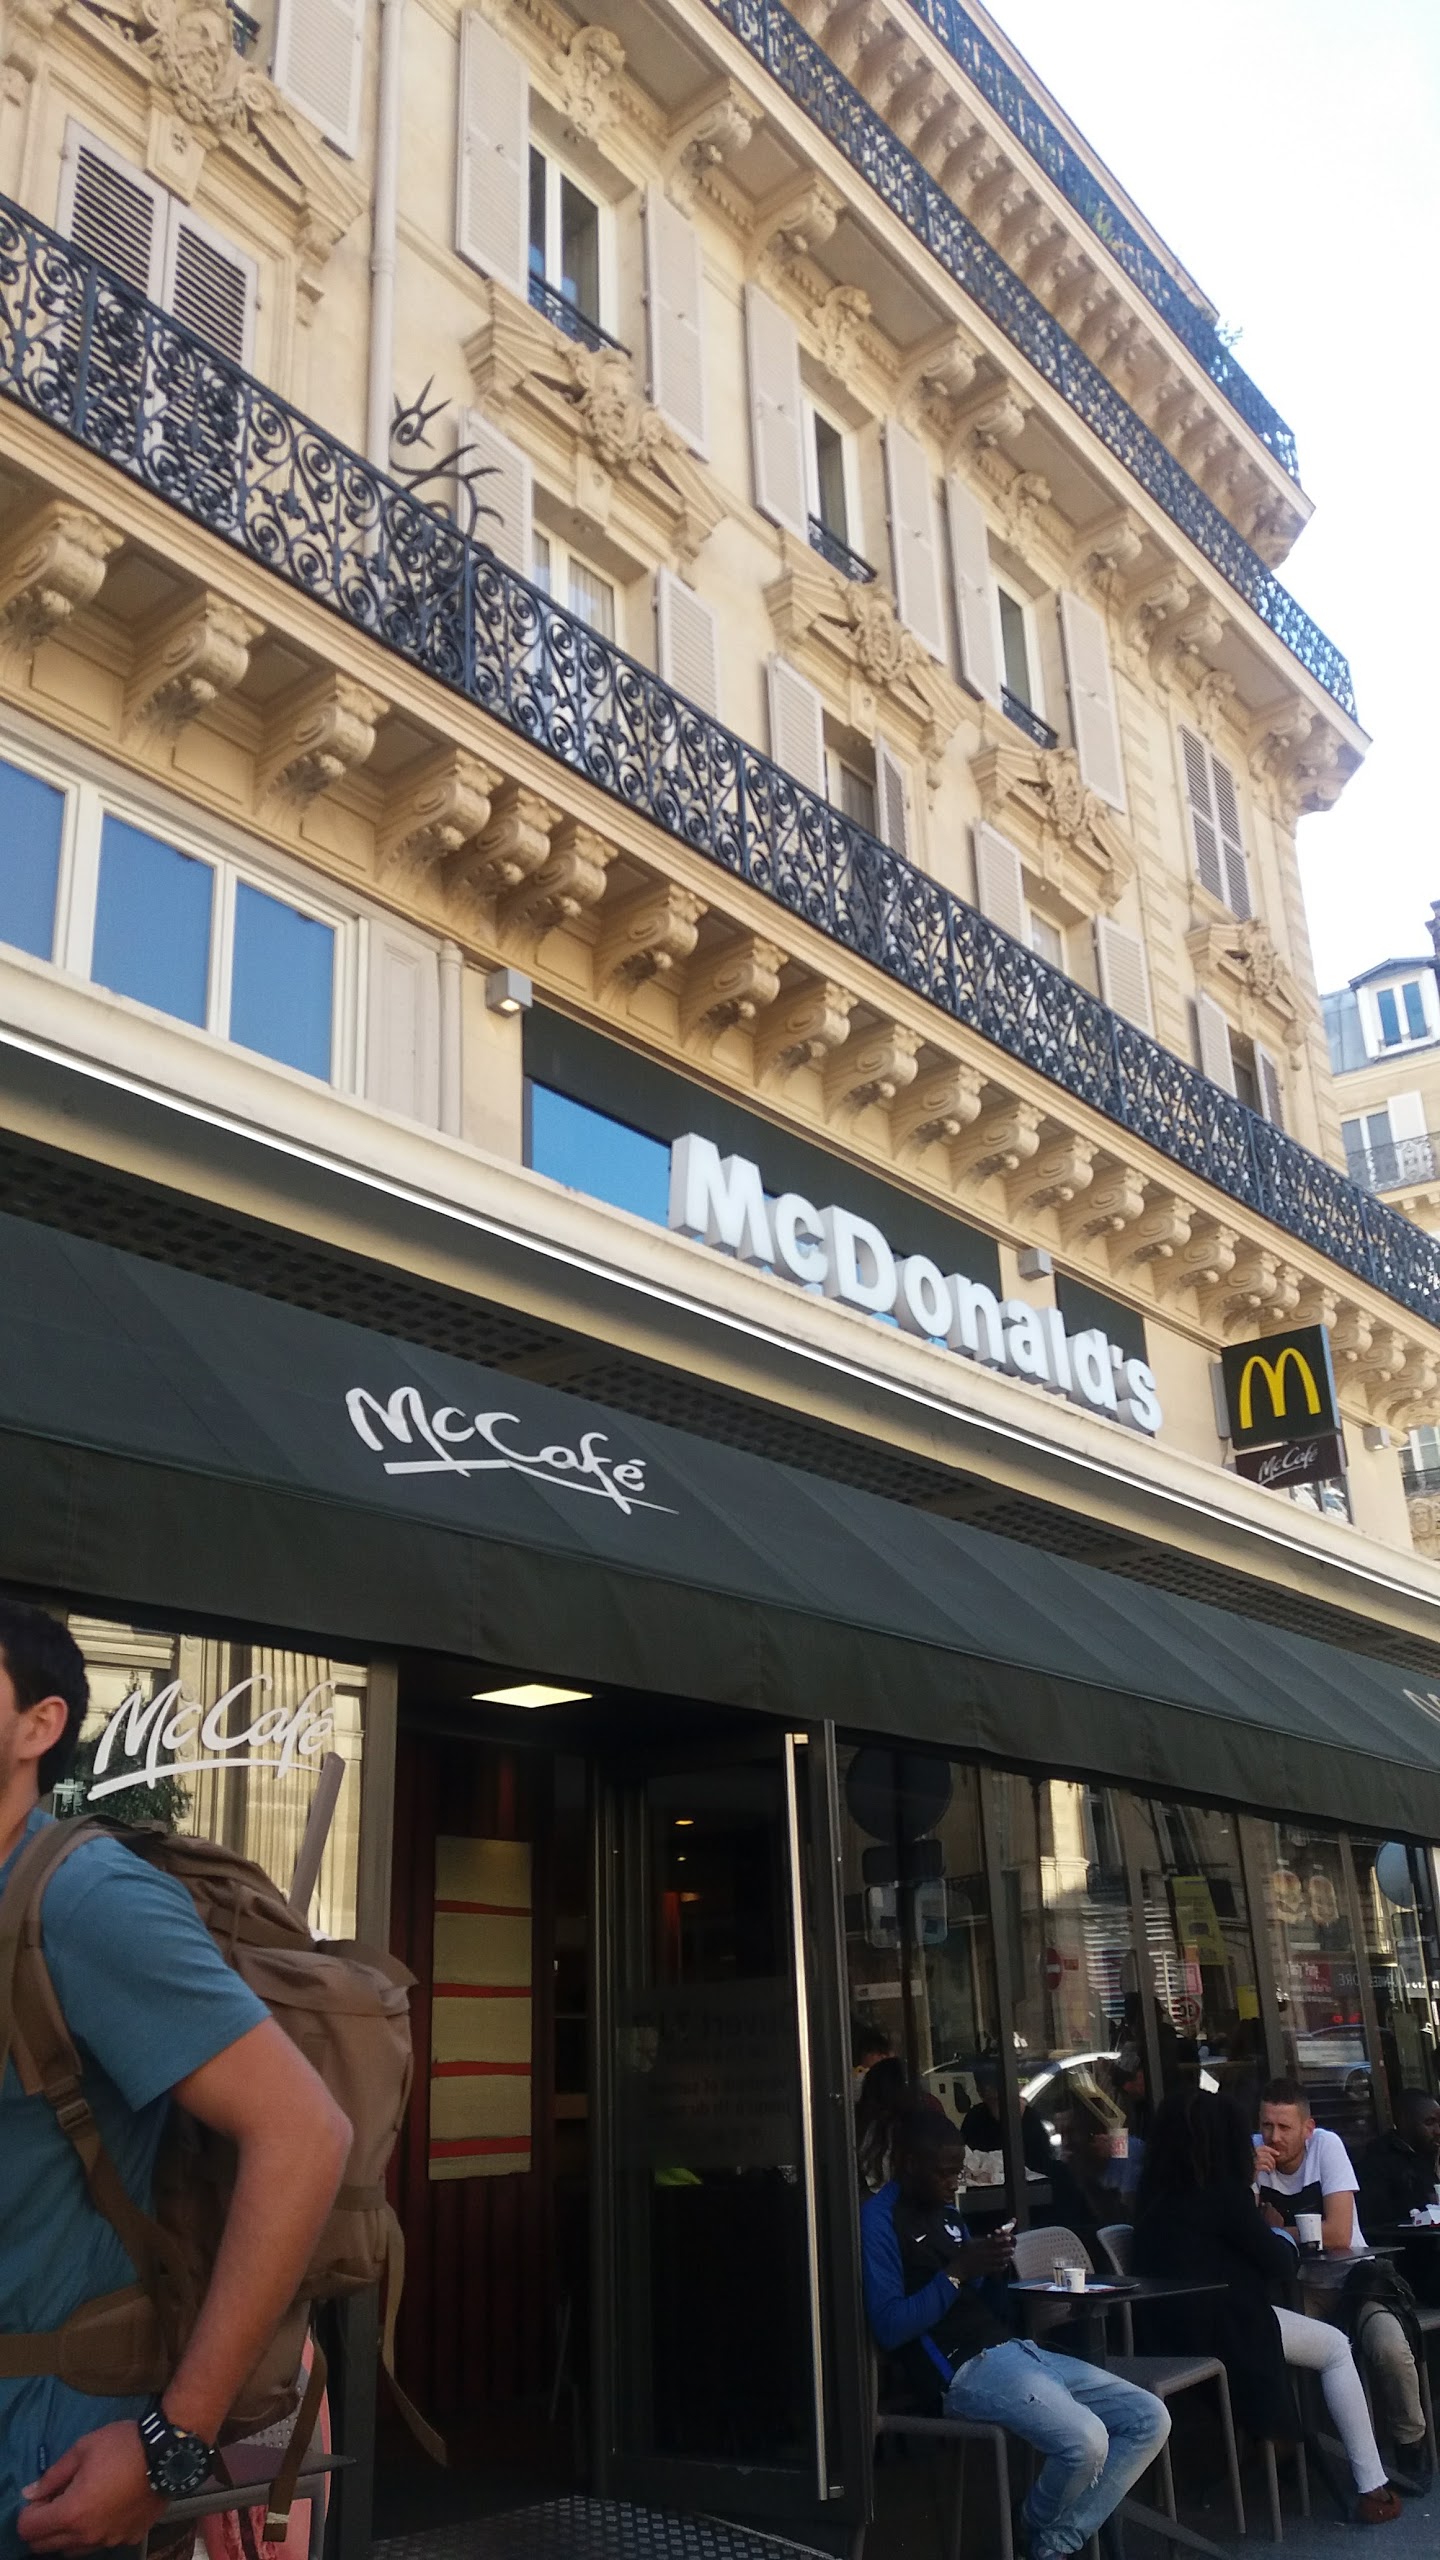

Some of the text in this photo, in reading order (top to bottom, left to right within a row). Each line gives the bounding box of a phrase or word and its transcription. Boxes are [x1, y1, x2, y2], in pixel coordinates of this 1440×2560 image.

[668, 1132, 1163, 1436] McDonald's
[345, 1386, 649, 1515] McCafé
[90, 1673, 338, 1794] McCafé
